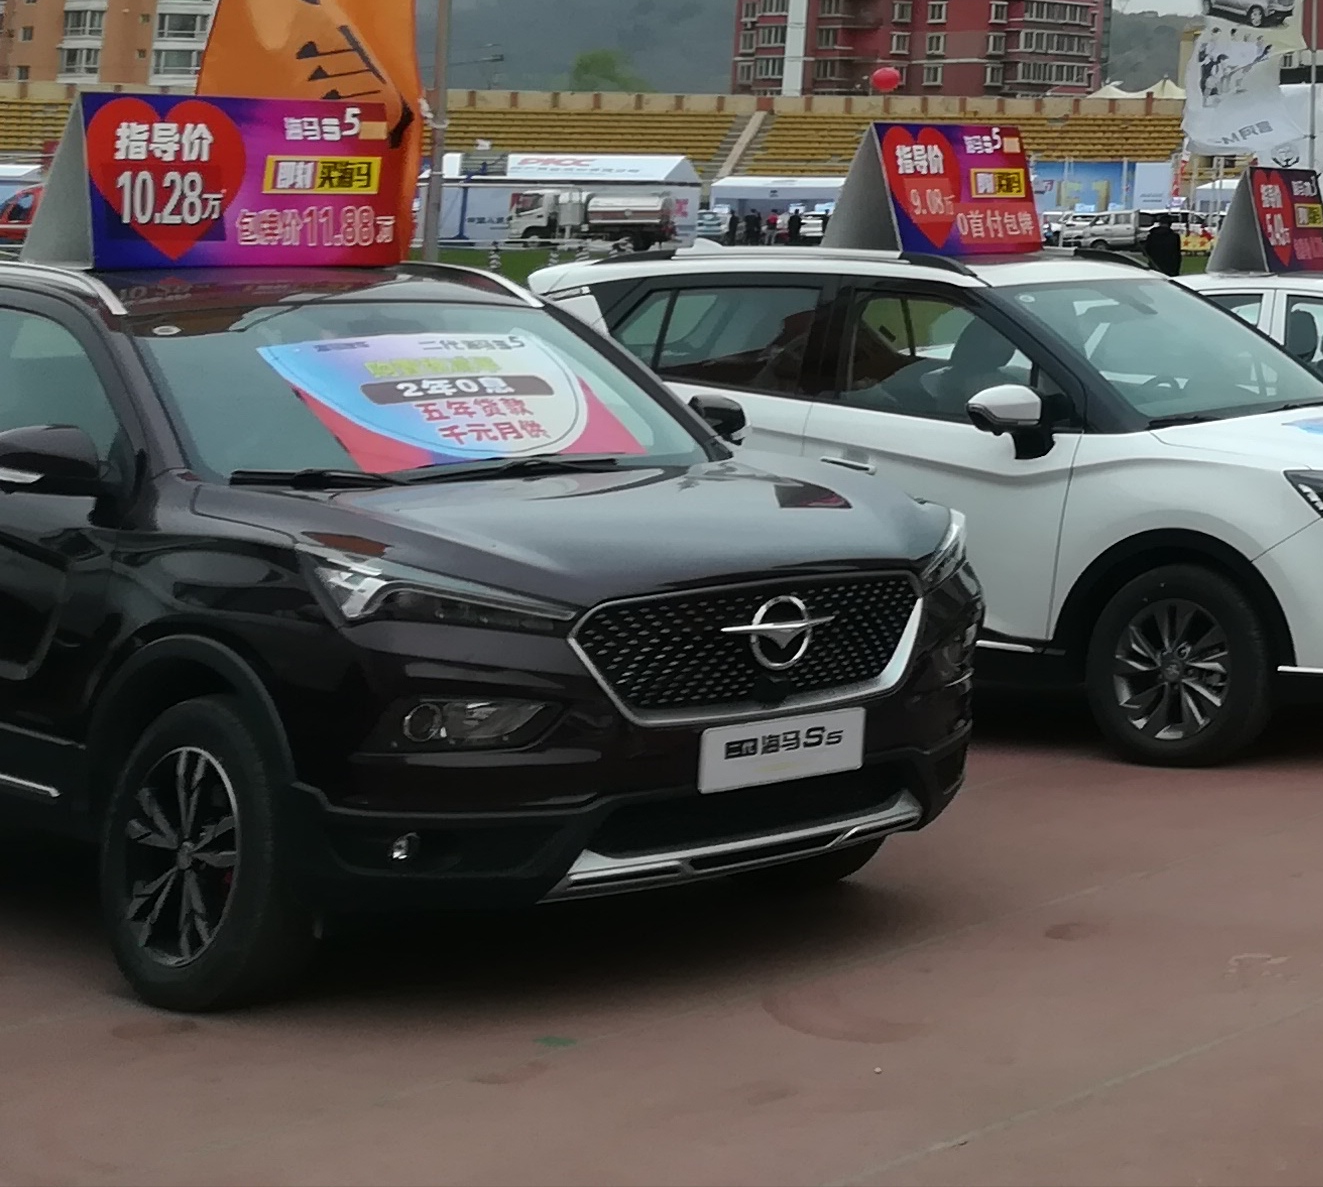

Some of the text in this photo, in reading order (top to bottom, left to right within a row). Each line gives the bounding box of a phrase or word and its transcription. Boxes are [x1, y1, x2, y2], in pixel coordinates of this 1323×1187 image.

[114, 122, 214, 162] 指导价
[895, 144, 944, 175] 指导价
[116, 171, 224, 225] 10.28万
[415, 397, 534, 422] 五年贷款
[438, 419, 551, 446] 千元月供
